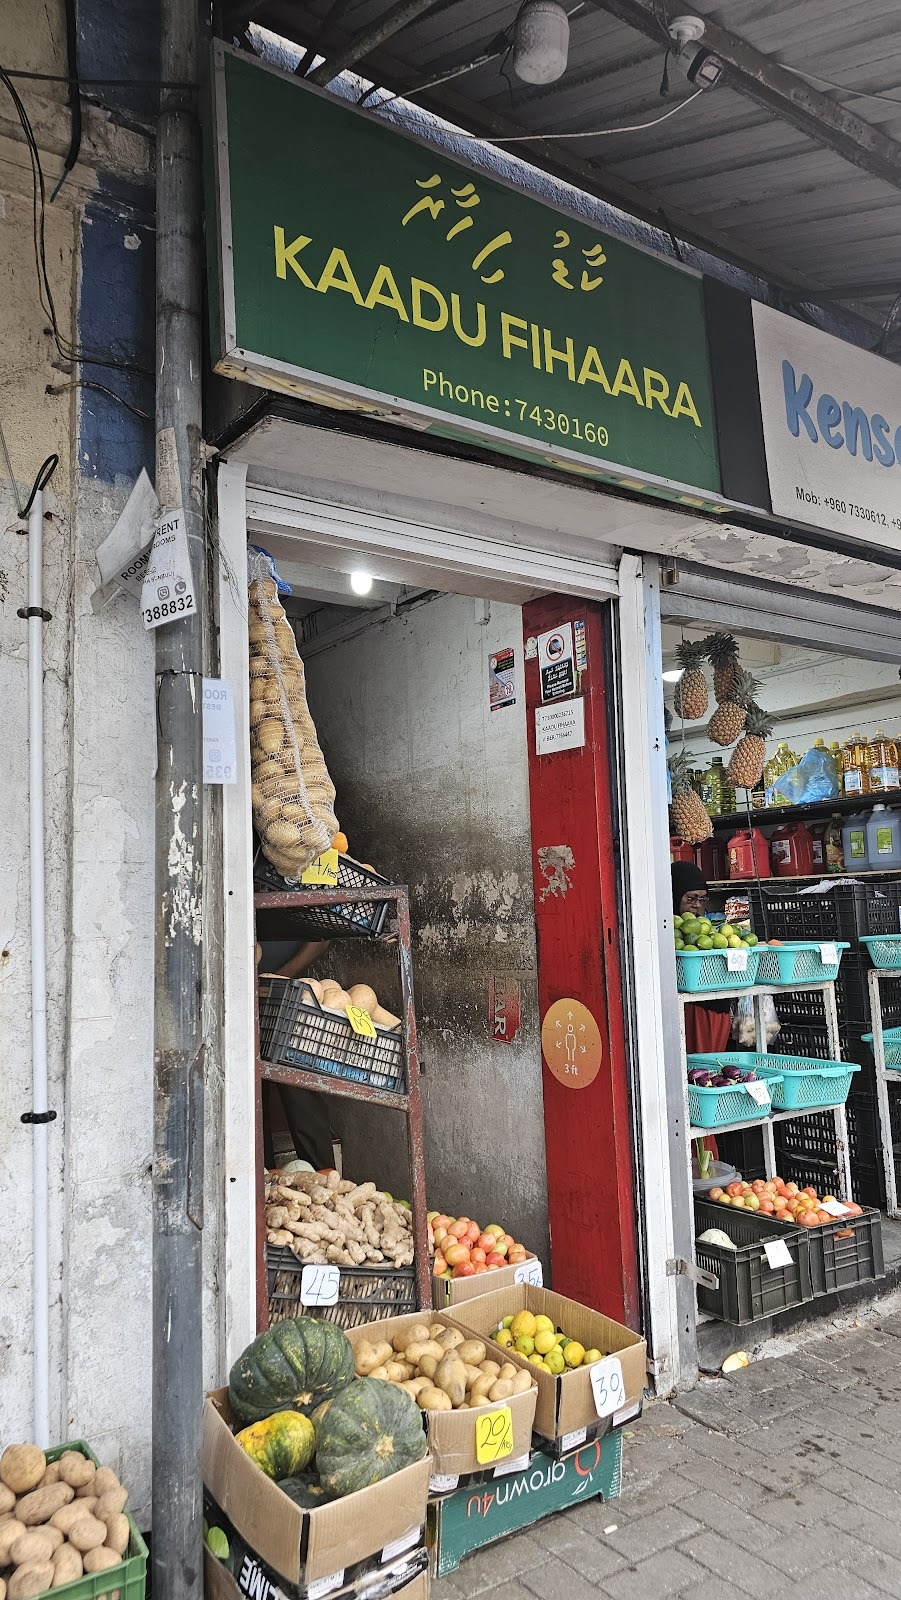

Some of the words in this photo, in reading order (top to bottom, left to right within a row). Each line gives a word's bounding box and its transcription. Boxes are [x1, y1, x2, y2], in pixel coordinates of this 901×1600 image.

[272, 225, 488, 348] KAADU
[500, 311, 703, 427] FIHAARA
[795, 486, 821, 506] Mob:
[824, 497, 847, 514] +960
[155, 518, 180, 539] RENT
[564, 1063, 570, 1074] 3
[571, 1064, 579, 1076] ft
[305, 1268, 340, 1305] 45
